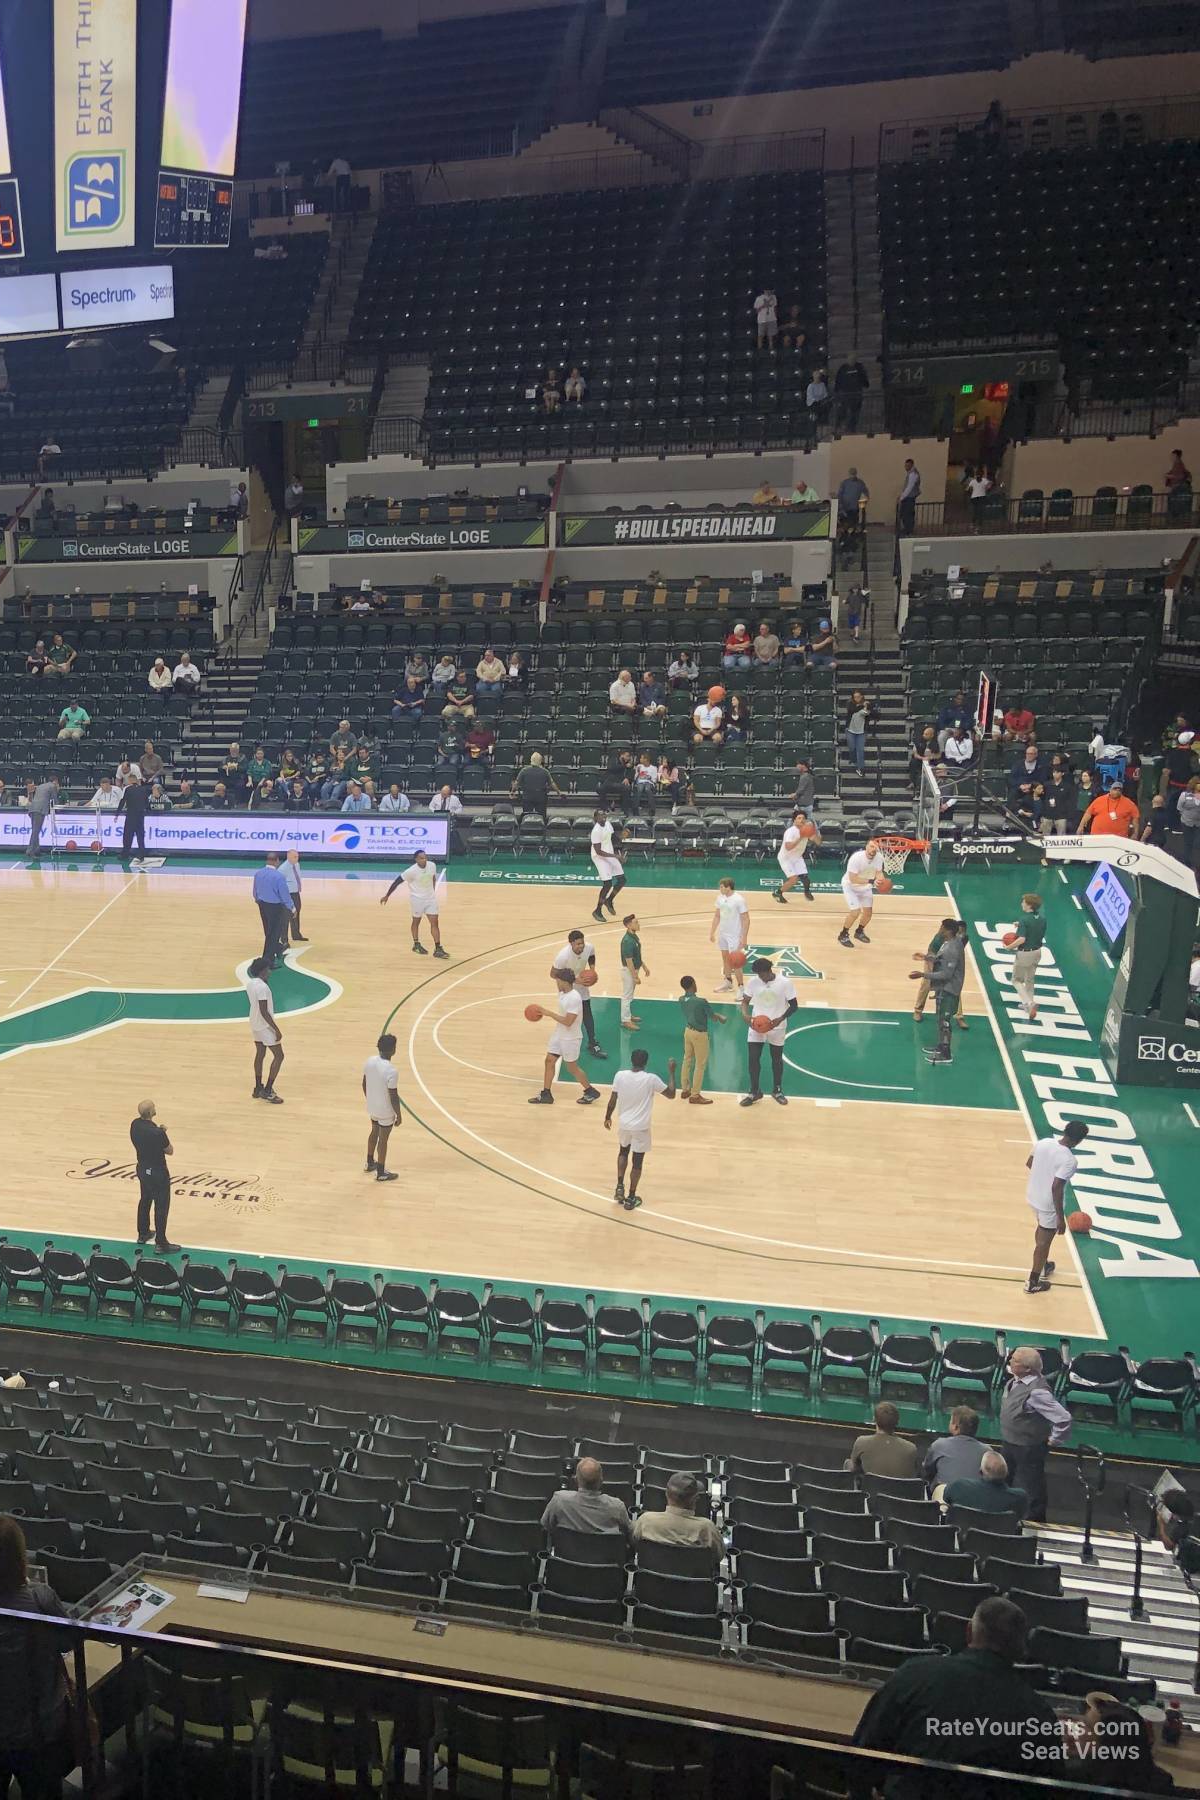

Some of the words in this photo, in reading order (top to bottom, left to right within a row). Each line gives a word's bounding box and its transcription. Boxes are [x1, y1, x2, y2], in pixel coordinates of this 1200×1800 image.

[76, 60, 91, 136] FIFTH
[98, 58, 113, 136] BANK
[71, 287, 134, 310] Spectrum
[892, 366, 925, 383] 214
[1015, 359, 1050, 376] 215
[248, 403, 276, 417] 213
[614, 516, 776, 540] #BULLSPEEDAHEAD
[79, 541, 151, 556] CenterState
[154, 539, 190, 554] LOGE
[365, 530, 447, 548] CenterState
[449, 530, 490, 545] LOGE
[365, 826, 429, 837] TECO
[952, 843, 1011, 856] Spectrum
[1040, 838, 1083, 848] SPALDING
[1106, 885, 1126, 917] TECO
[174, 1189, 260, 1203] CENTER
